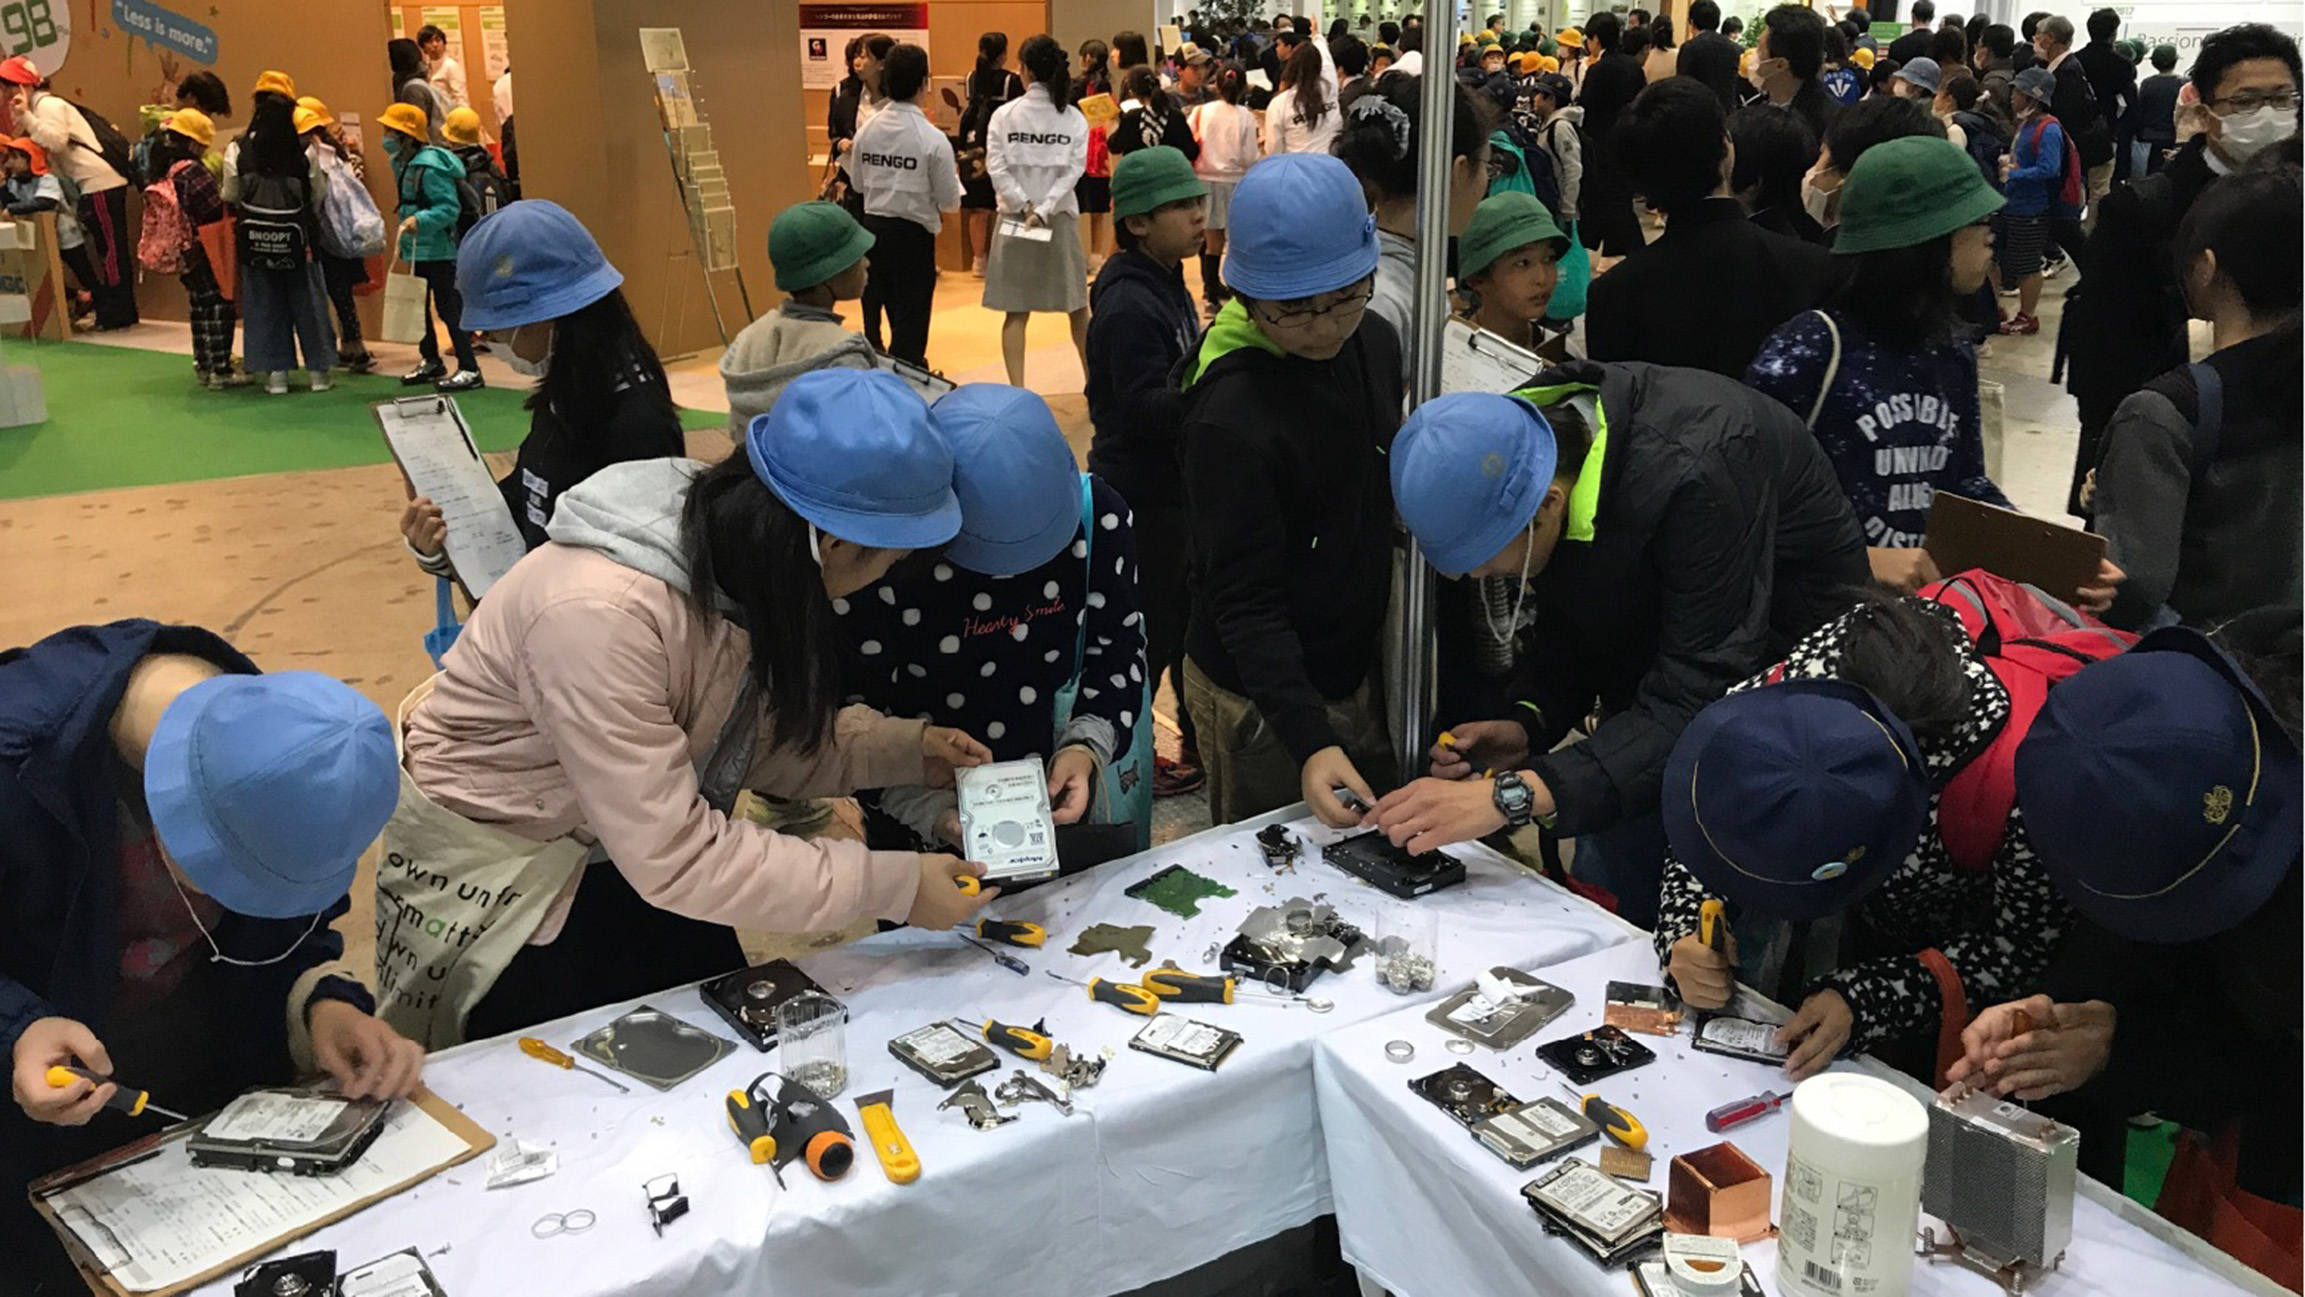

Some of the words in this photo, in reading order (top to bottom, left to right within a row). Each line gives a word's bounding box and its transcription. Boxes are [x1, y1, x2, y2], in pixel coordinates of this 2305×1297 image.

[155, 15, 166, 36] is
[1007, 132, 1071, 145] RENGO
[861, 152, 917, 170] RENGO
